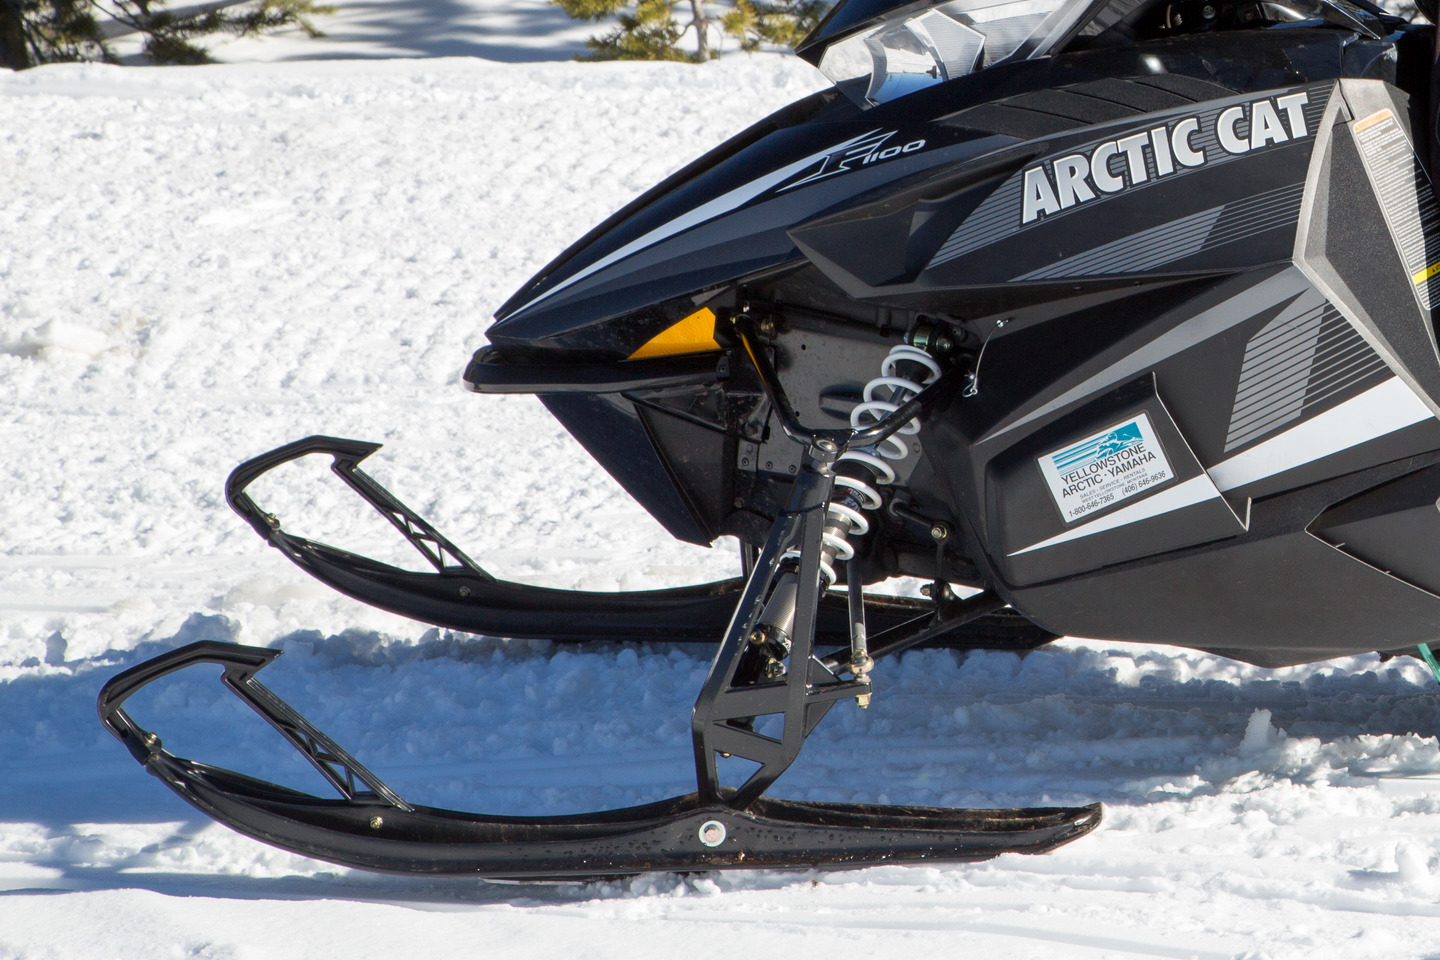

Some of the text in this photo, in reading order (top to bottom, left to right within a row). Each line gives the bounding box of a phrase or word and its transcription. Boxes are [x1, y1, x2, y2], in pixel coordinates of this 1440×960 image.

[1022, 91, 1309, 225] ARCTIC CAT
[1061, 443, 1146, 485] YELLOWSTONE
[1061, 450, 1156, 498] ARCTIC YAMAHA
[1080, 467, 1145, 499] SALES SERVICE RENTALS
